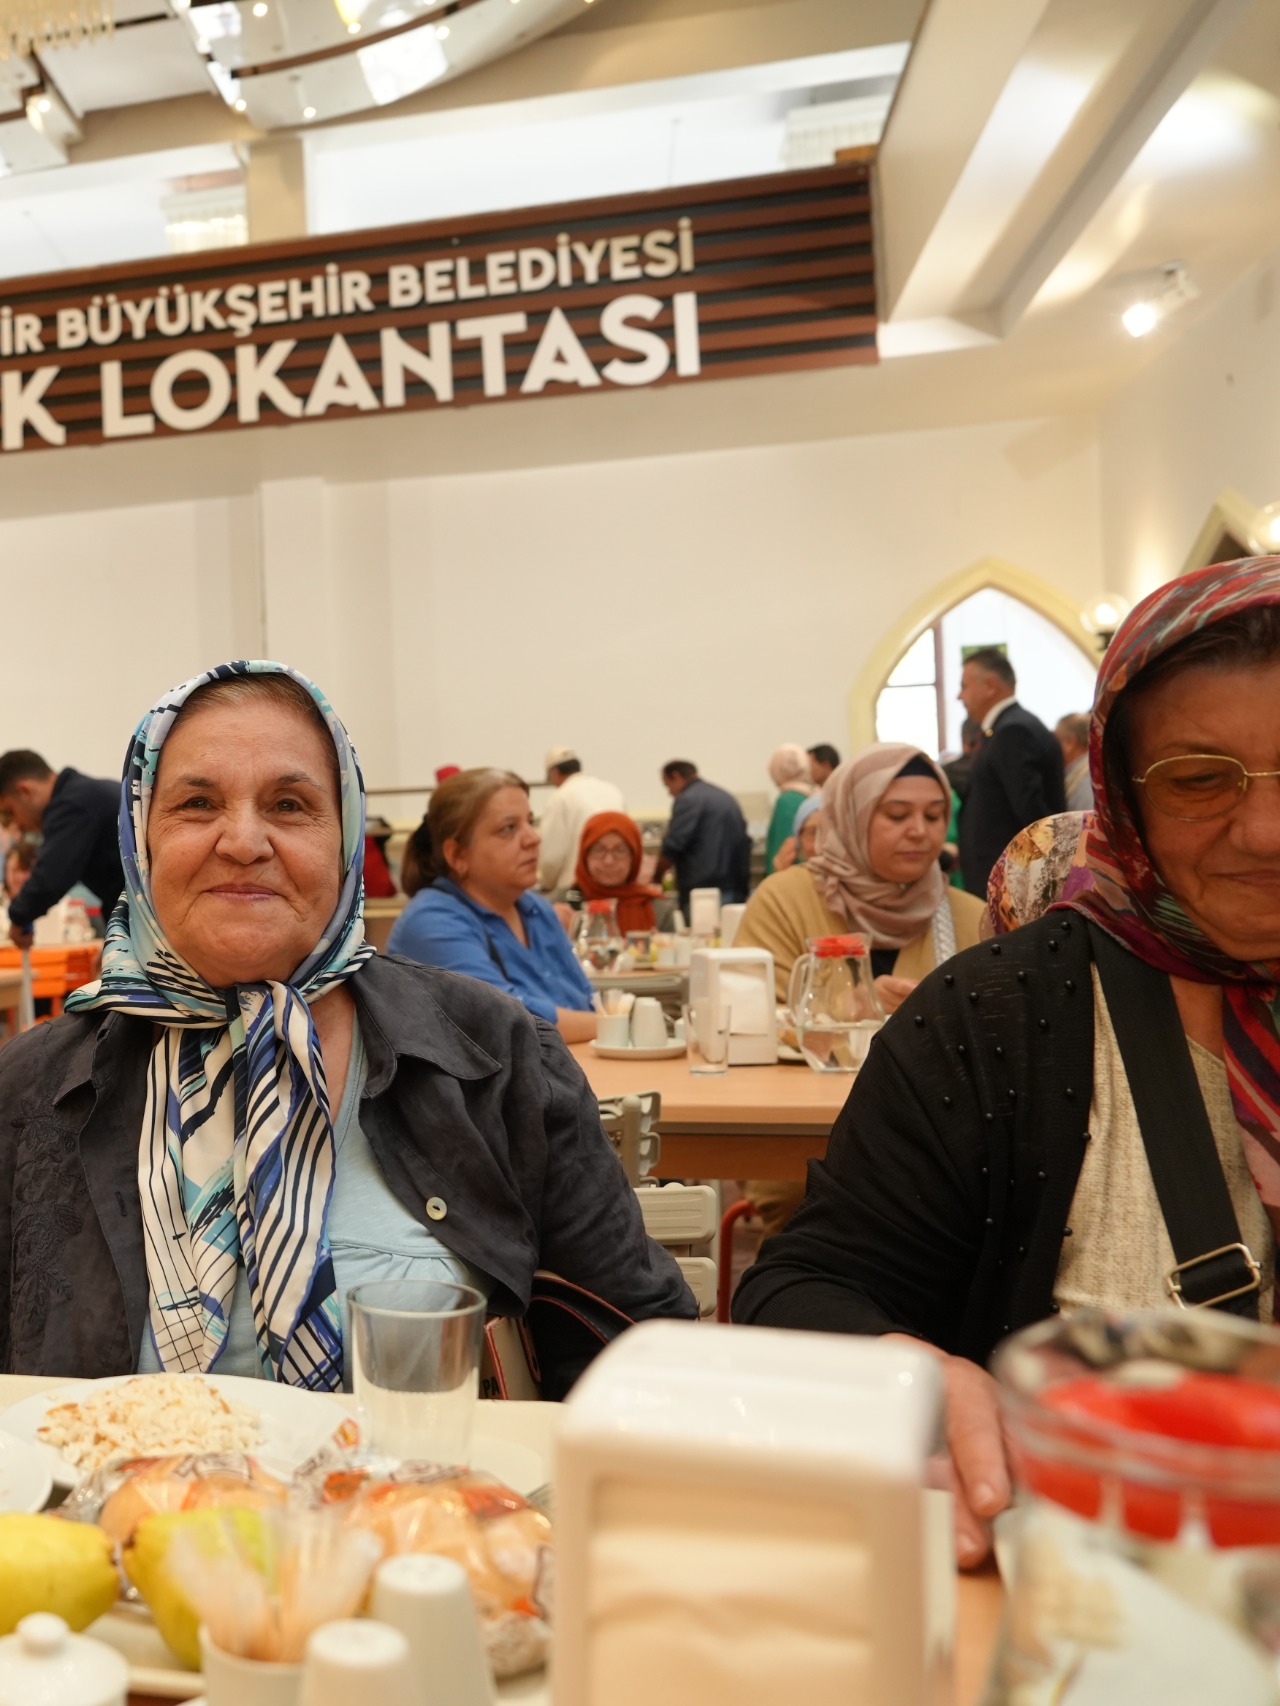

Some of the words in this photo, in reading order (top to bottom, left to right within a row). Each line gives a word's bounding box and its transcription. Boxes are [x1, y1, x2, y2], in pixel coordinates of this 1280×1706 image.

[57, 263, 375, 348] BÜYÜKŞEHİR
[389, 218, 694, 307] BELEDİYESİ
[101, 291, 701, 438] LOKANTASI
